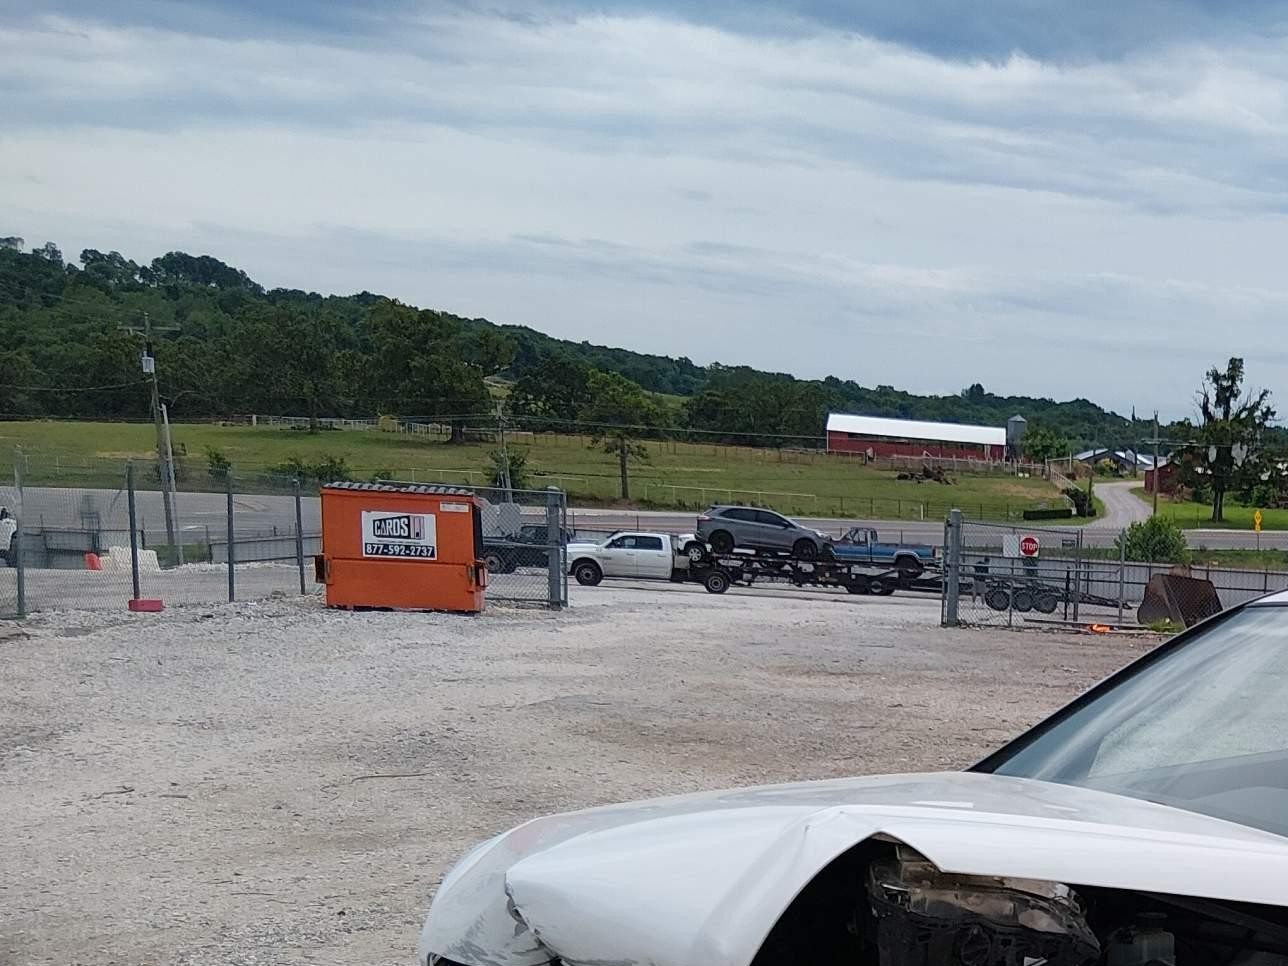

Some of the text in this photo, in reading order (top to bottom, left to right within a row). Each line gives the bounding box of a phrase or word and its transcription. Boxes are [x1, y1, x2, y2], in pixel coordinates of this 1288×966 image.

[374, 517, 408, 536] CARDS
[366, 544, 433, 556] 877-592-2737
[1022, 542, 1038, 551] STOP
